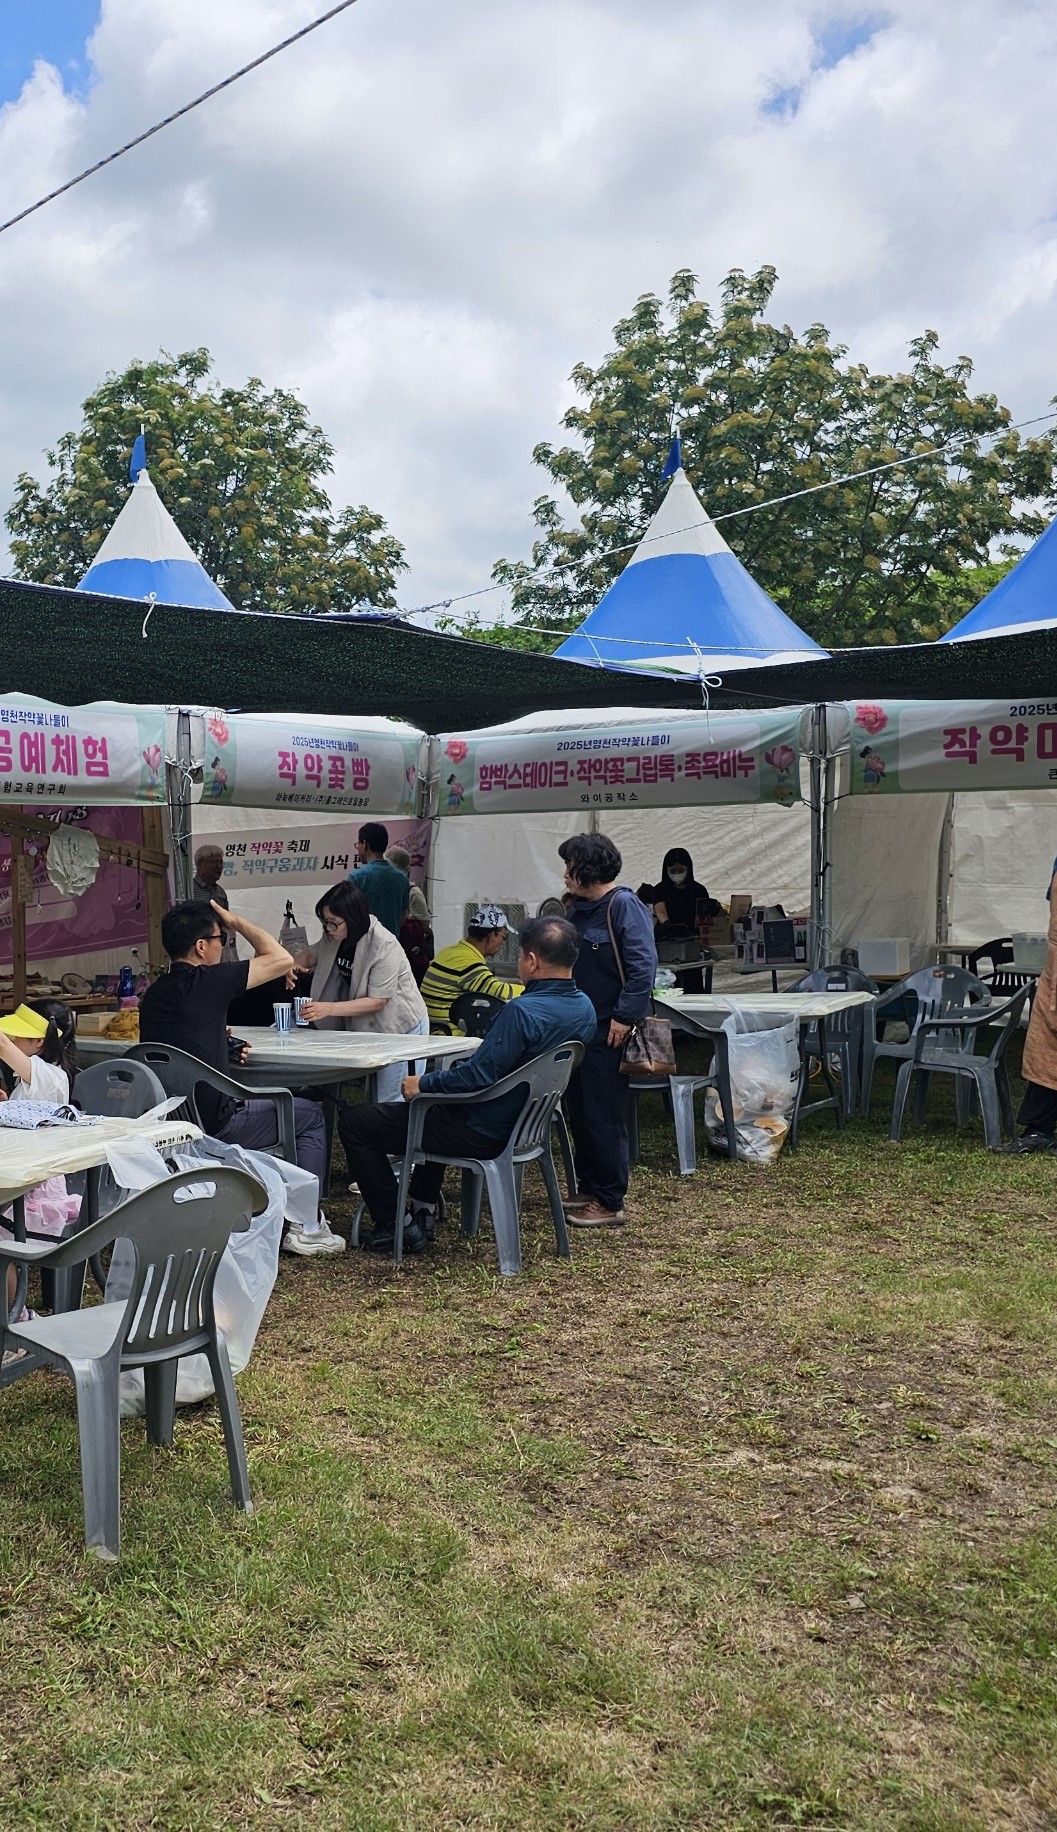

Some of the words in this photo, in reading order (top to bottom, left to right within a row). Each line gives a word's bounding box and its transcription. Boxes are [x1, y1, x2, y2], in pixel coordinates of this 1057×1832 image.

[557, 734, 670, 751] 2025년영천작약꽃나들이
[278, 751, 371, 791] 작약꽃빵
[580, 792, 639, 803] 와이공작소
[225, 843, 247, 857] 영천
[250, 841, 284, 855] 작약꽃
[286, 839, 311, 853] 축제
[320, 854, 349, 870] 시식
